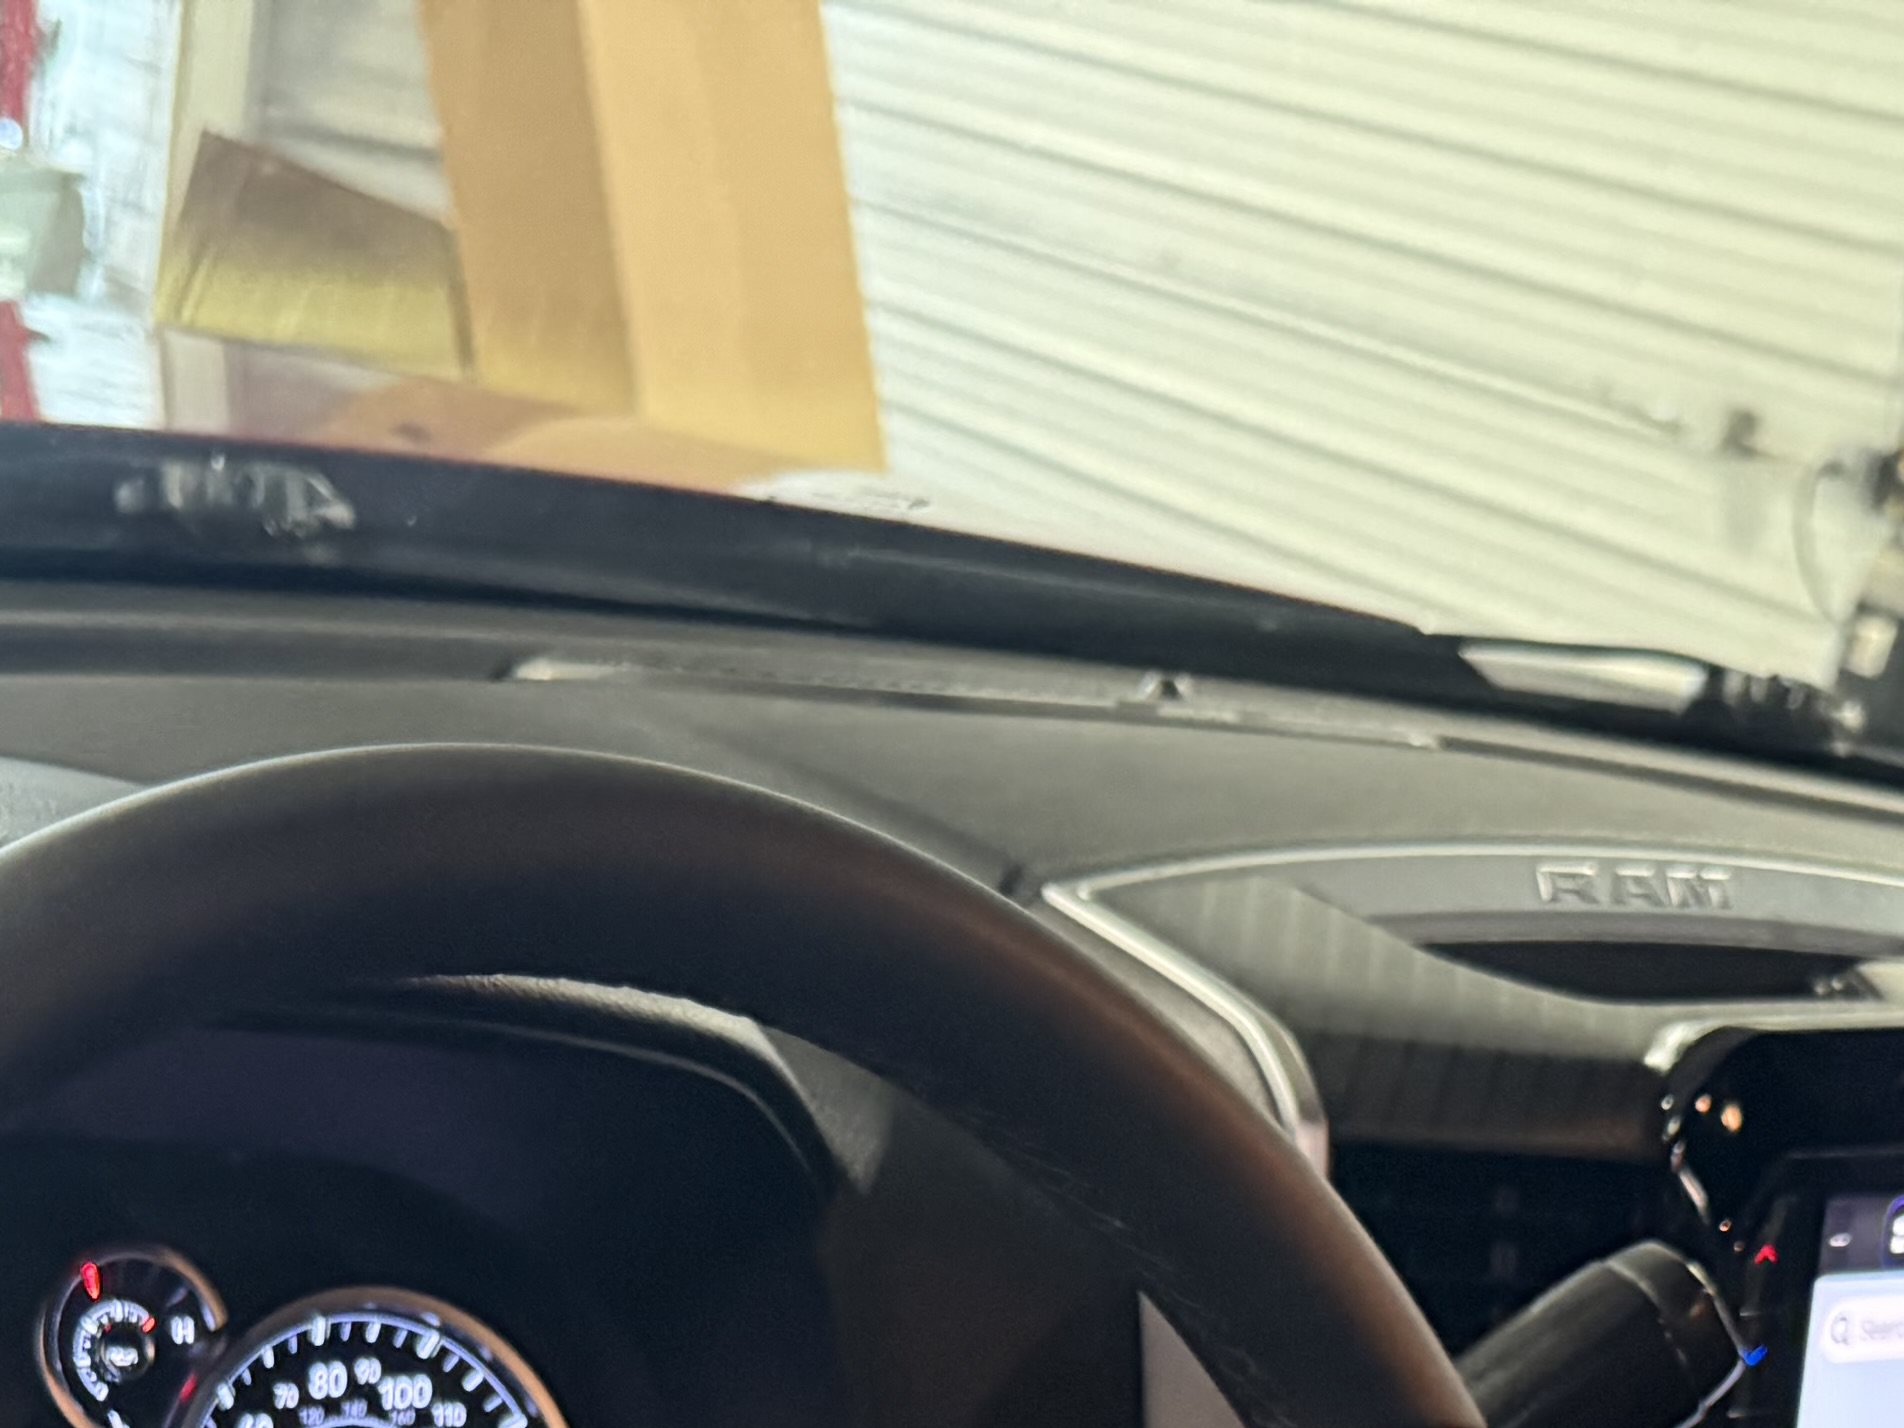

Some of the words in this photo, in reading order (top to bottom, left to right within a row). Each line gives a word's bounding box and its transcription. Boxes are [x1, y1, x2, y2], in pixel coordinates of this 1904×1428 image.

[308, 1361, 347, 1400] 80
[354, 1357, 382, 1385] 90
[273, 1382, 299, 1409] 70
[377, 1373, 432, 1410] 100
[431, 1401, 467, 1428] 110
